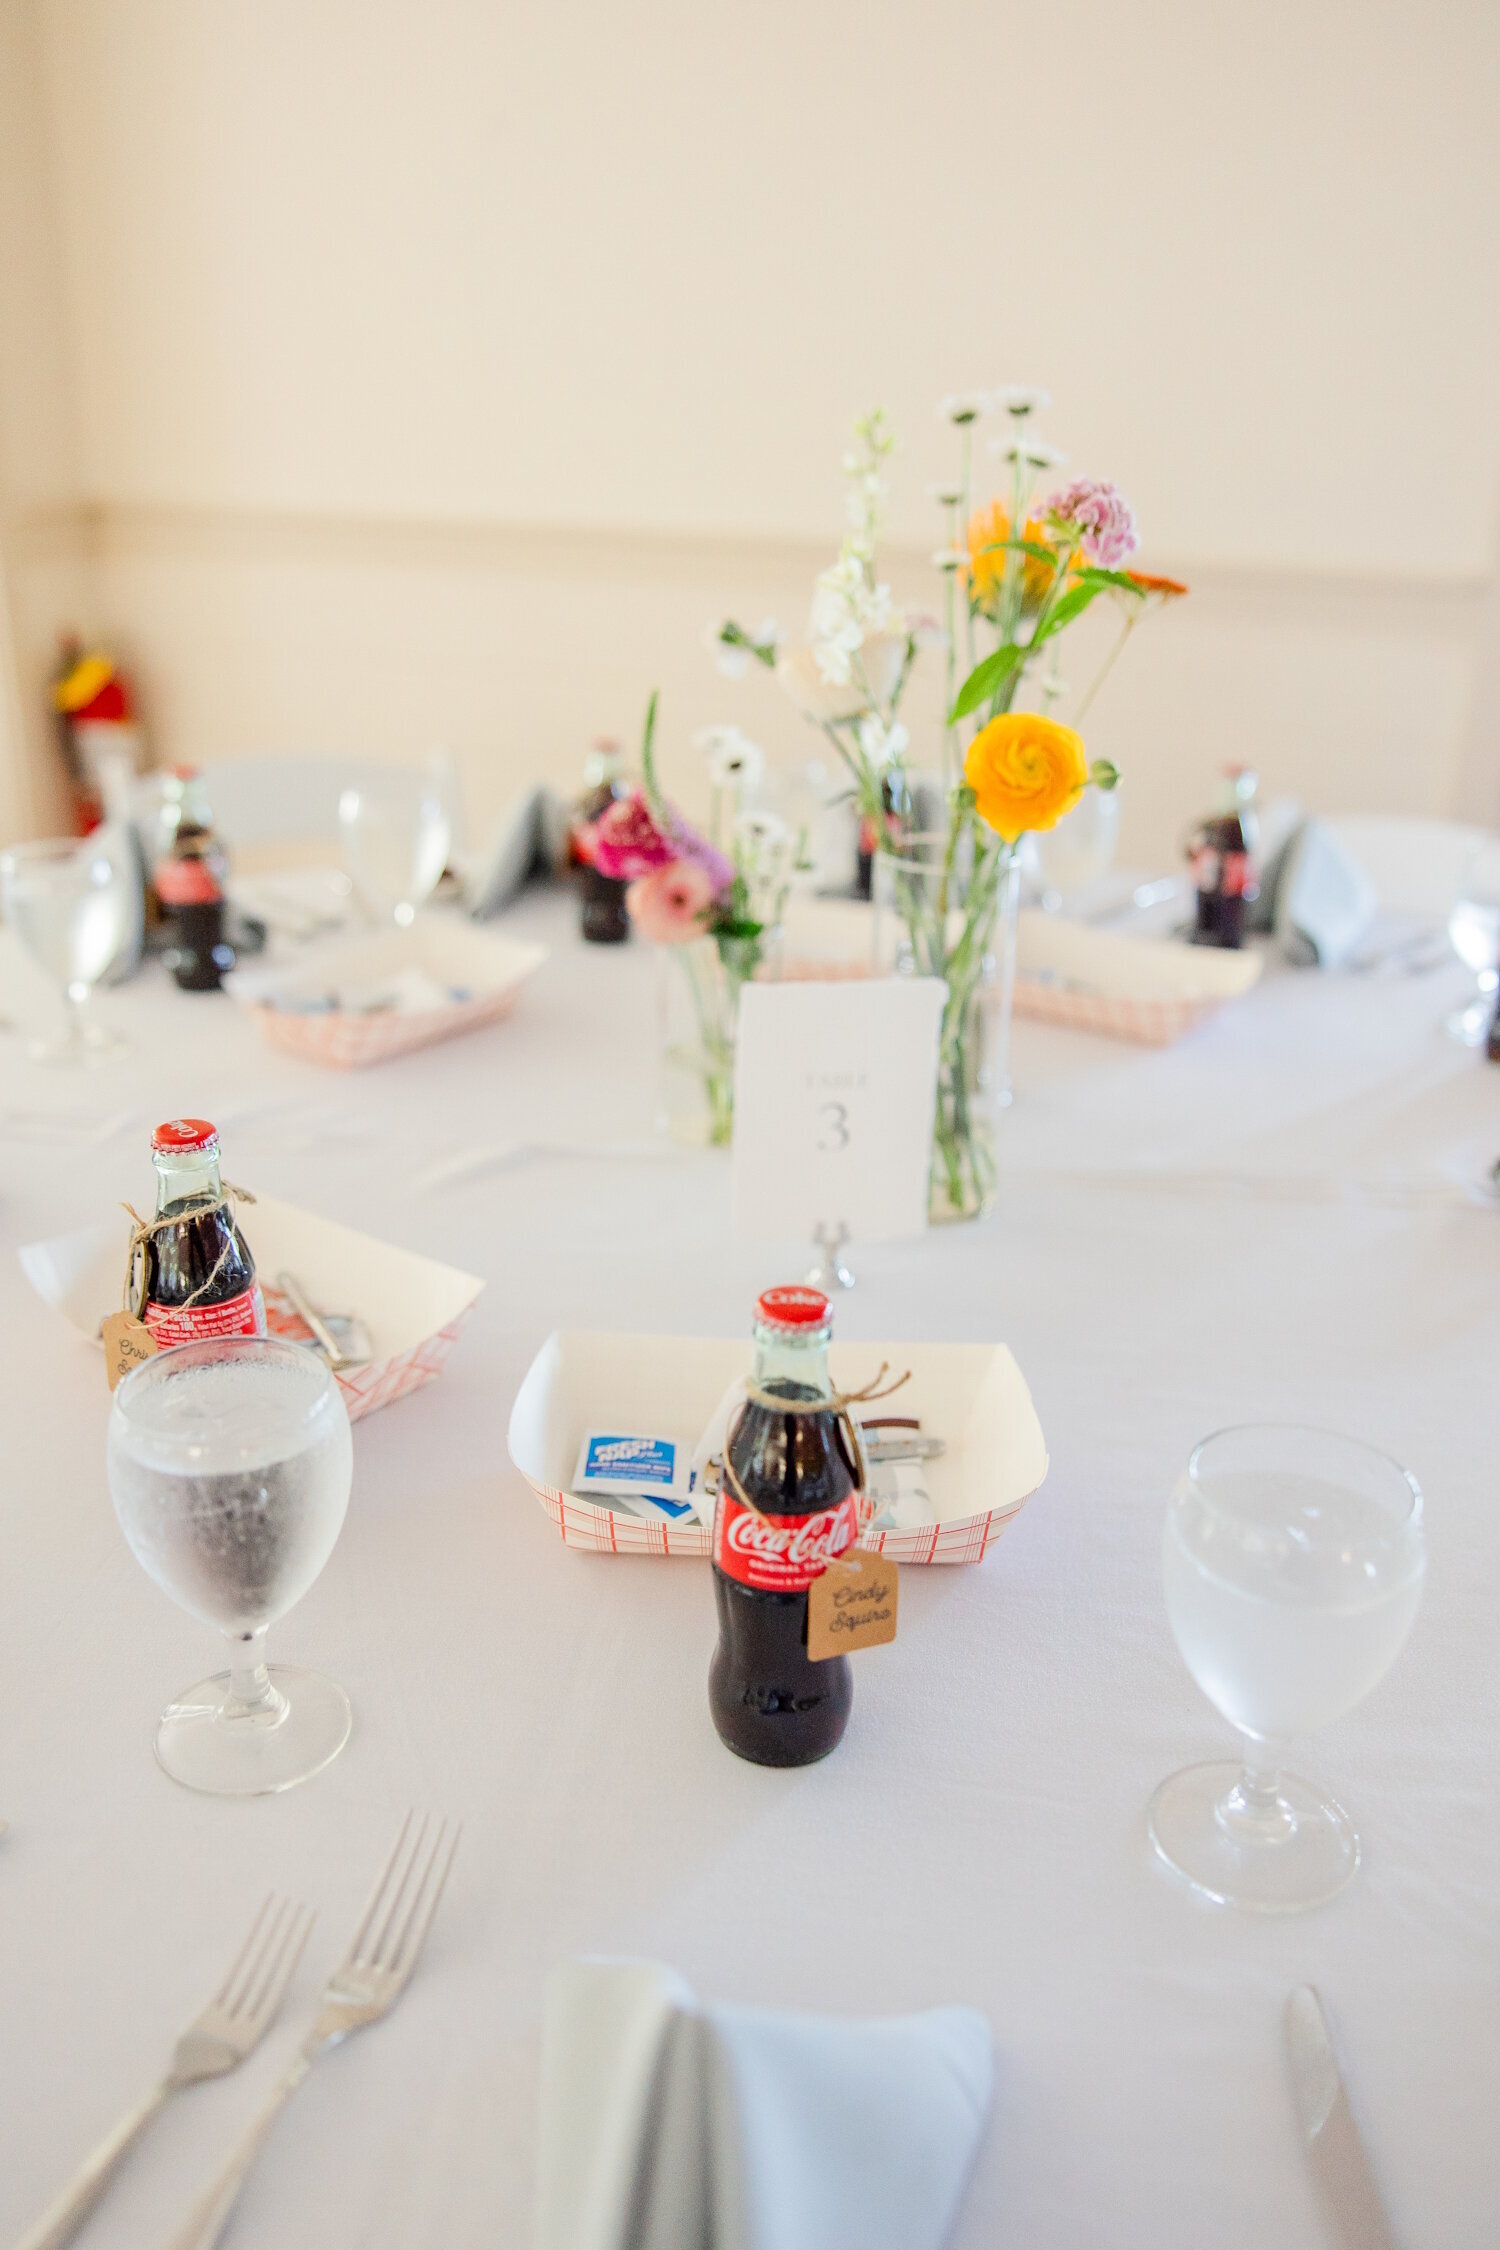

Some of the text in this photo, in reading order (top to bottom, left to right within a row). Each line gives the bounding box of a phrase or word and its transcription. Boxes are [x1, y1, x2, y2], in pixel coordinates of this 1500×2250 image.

[816, 1100, 851, 1152] 3
[764, 1291, 825, 1305] Coke
[728, 1498, 851, 1563] Coca-Cola
[832, 1579, 890, 1608] Cindy
